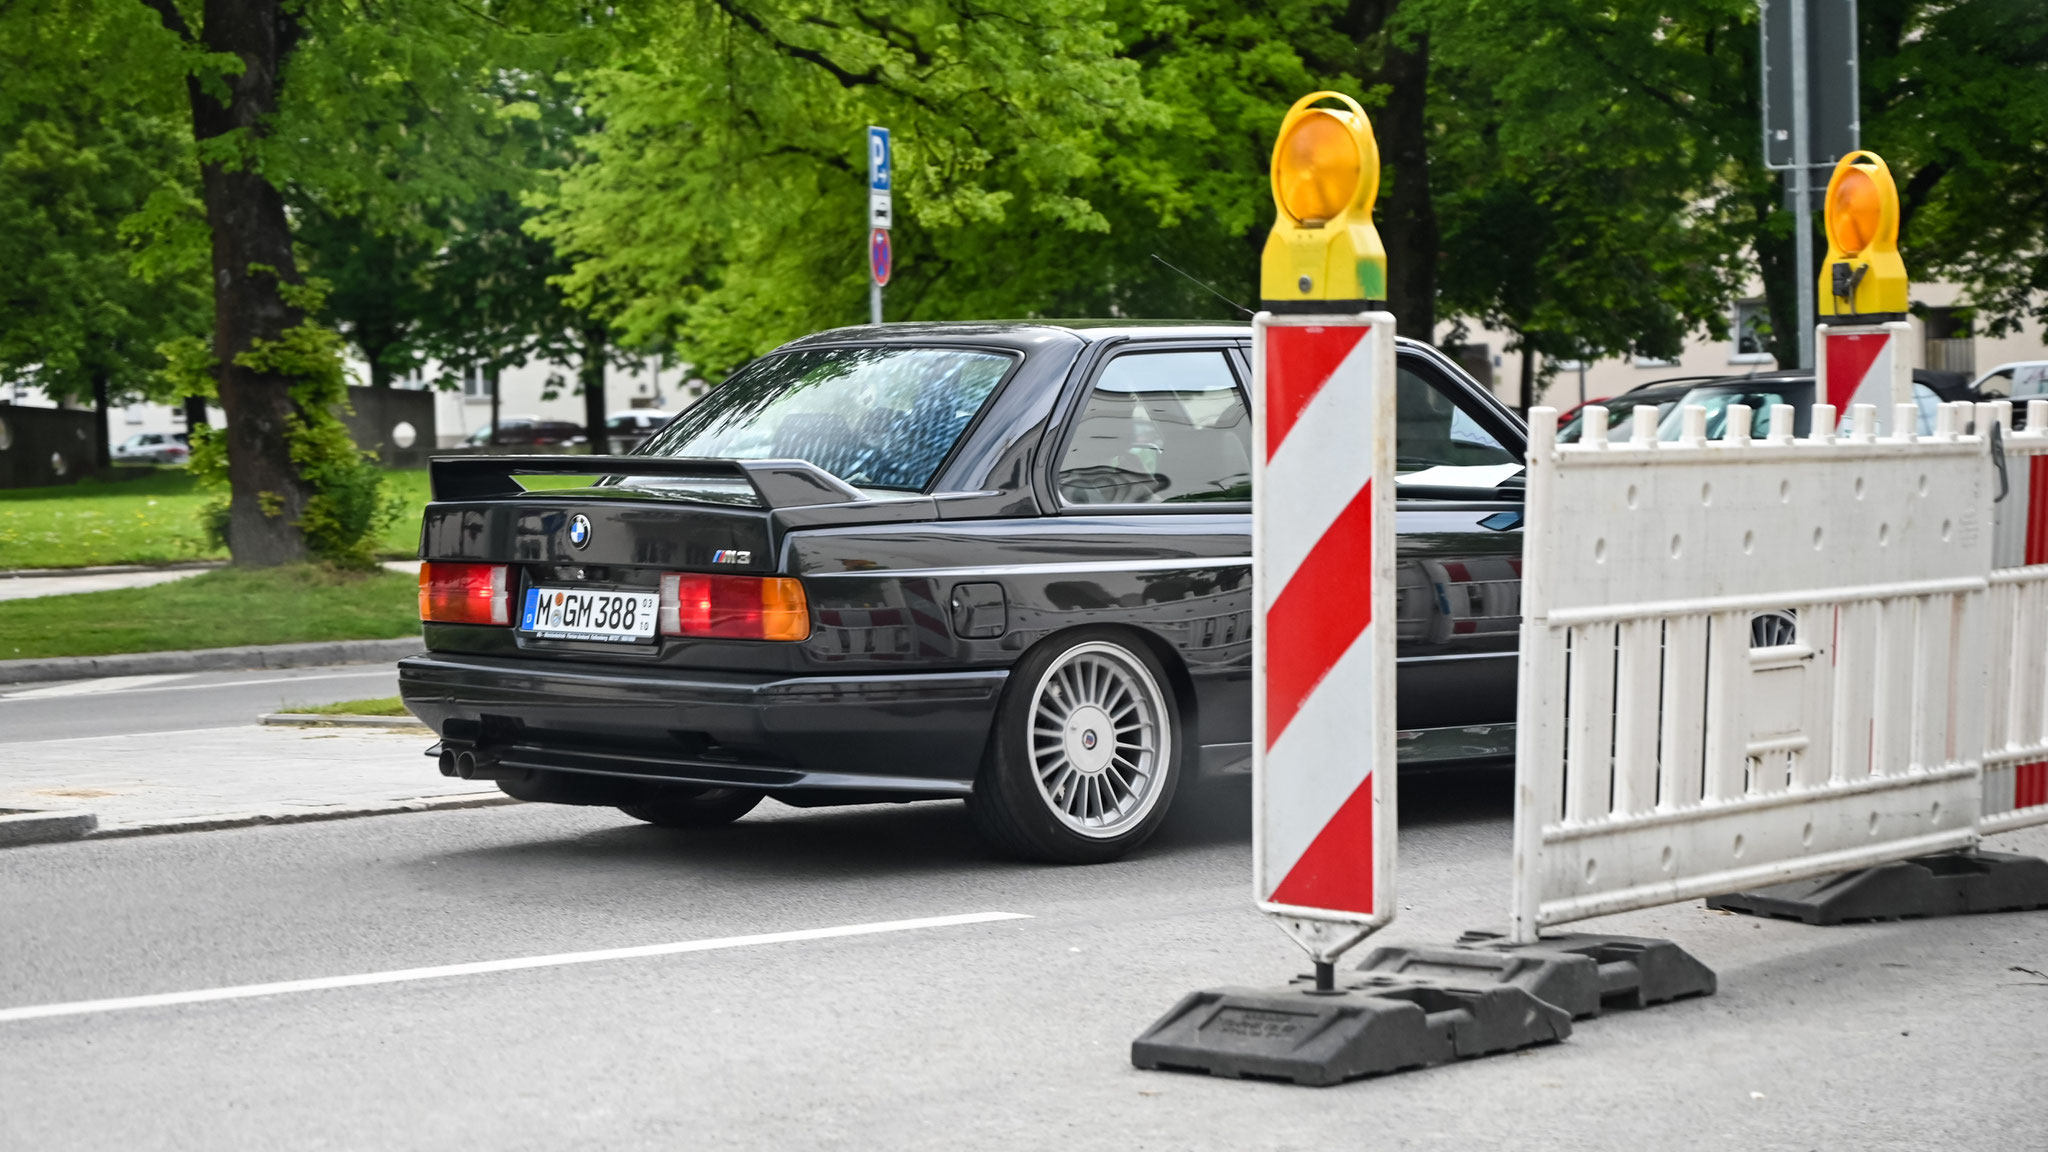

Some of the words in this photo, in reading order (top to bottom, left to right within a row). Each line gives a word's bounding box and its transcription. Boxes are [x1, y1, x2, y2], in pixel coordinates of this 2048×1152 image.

[872, 135, 885, 182] P
[717, 550, 751, 564] M3
[642, 598, 653, 608] 03
[536, 593, 553, 626] M
[563, 594, 594, 628] GM
[595, 596, 637, 630] 388
[640, 621, 650, 631] 10
